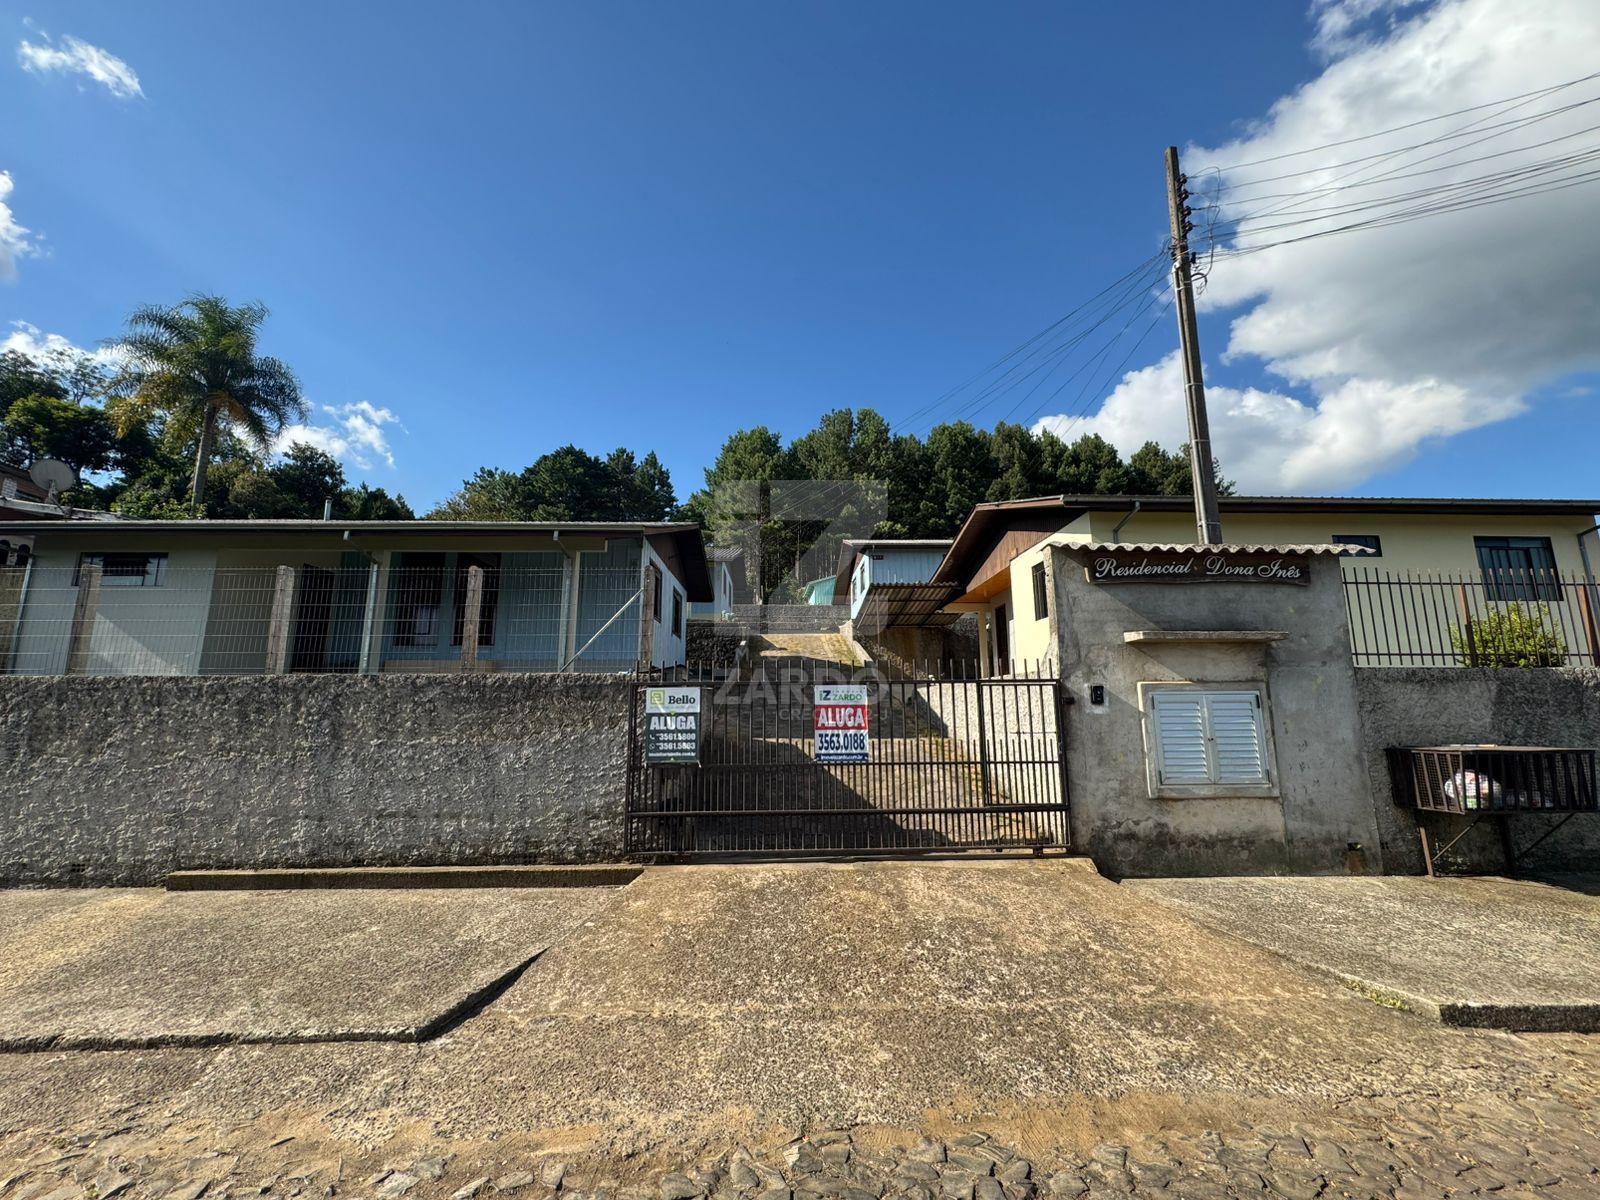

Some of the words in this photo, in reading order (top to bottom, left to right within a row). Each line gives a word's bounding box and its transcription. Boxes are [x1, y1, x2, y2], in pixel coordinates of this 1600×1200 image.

[1094, 557, 1194, 578] Residencial
[1204, 556, 1255, 576] Dona
[1257, 559, 1301, 578] Inês
[668, 695, 696, 704] Bello
[650, 716, 696, 730] ALUGA
[818, 707, 865, 727] ALUGA
[818, 733, 865, 751] 3563.0188
